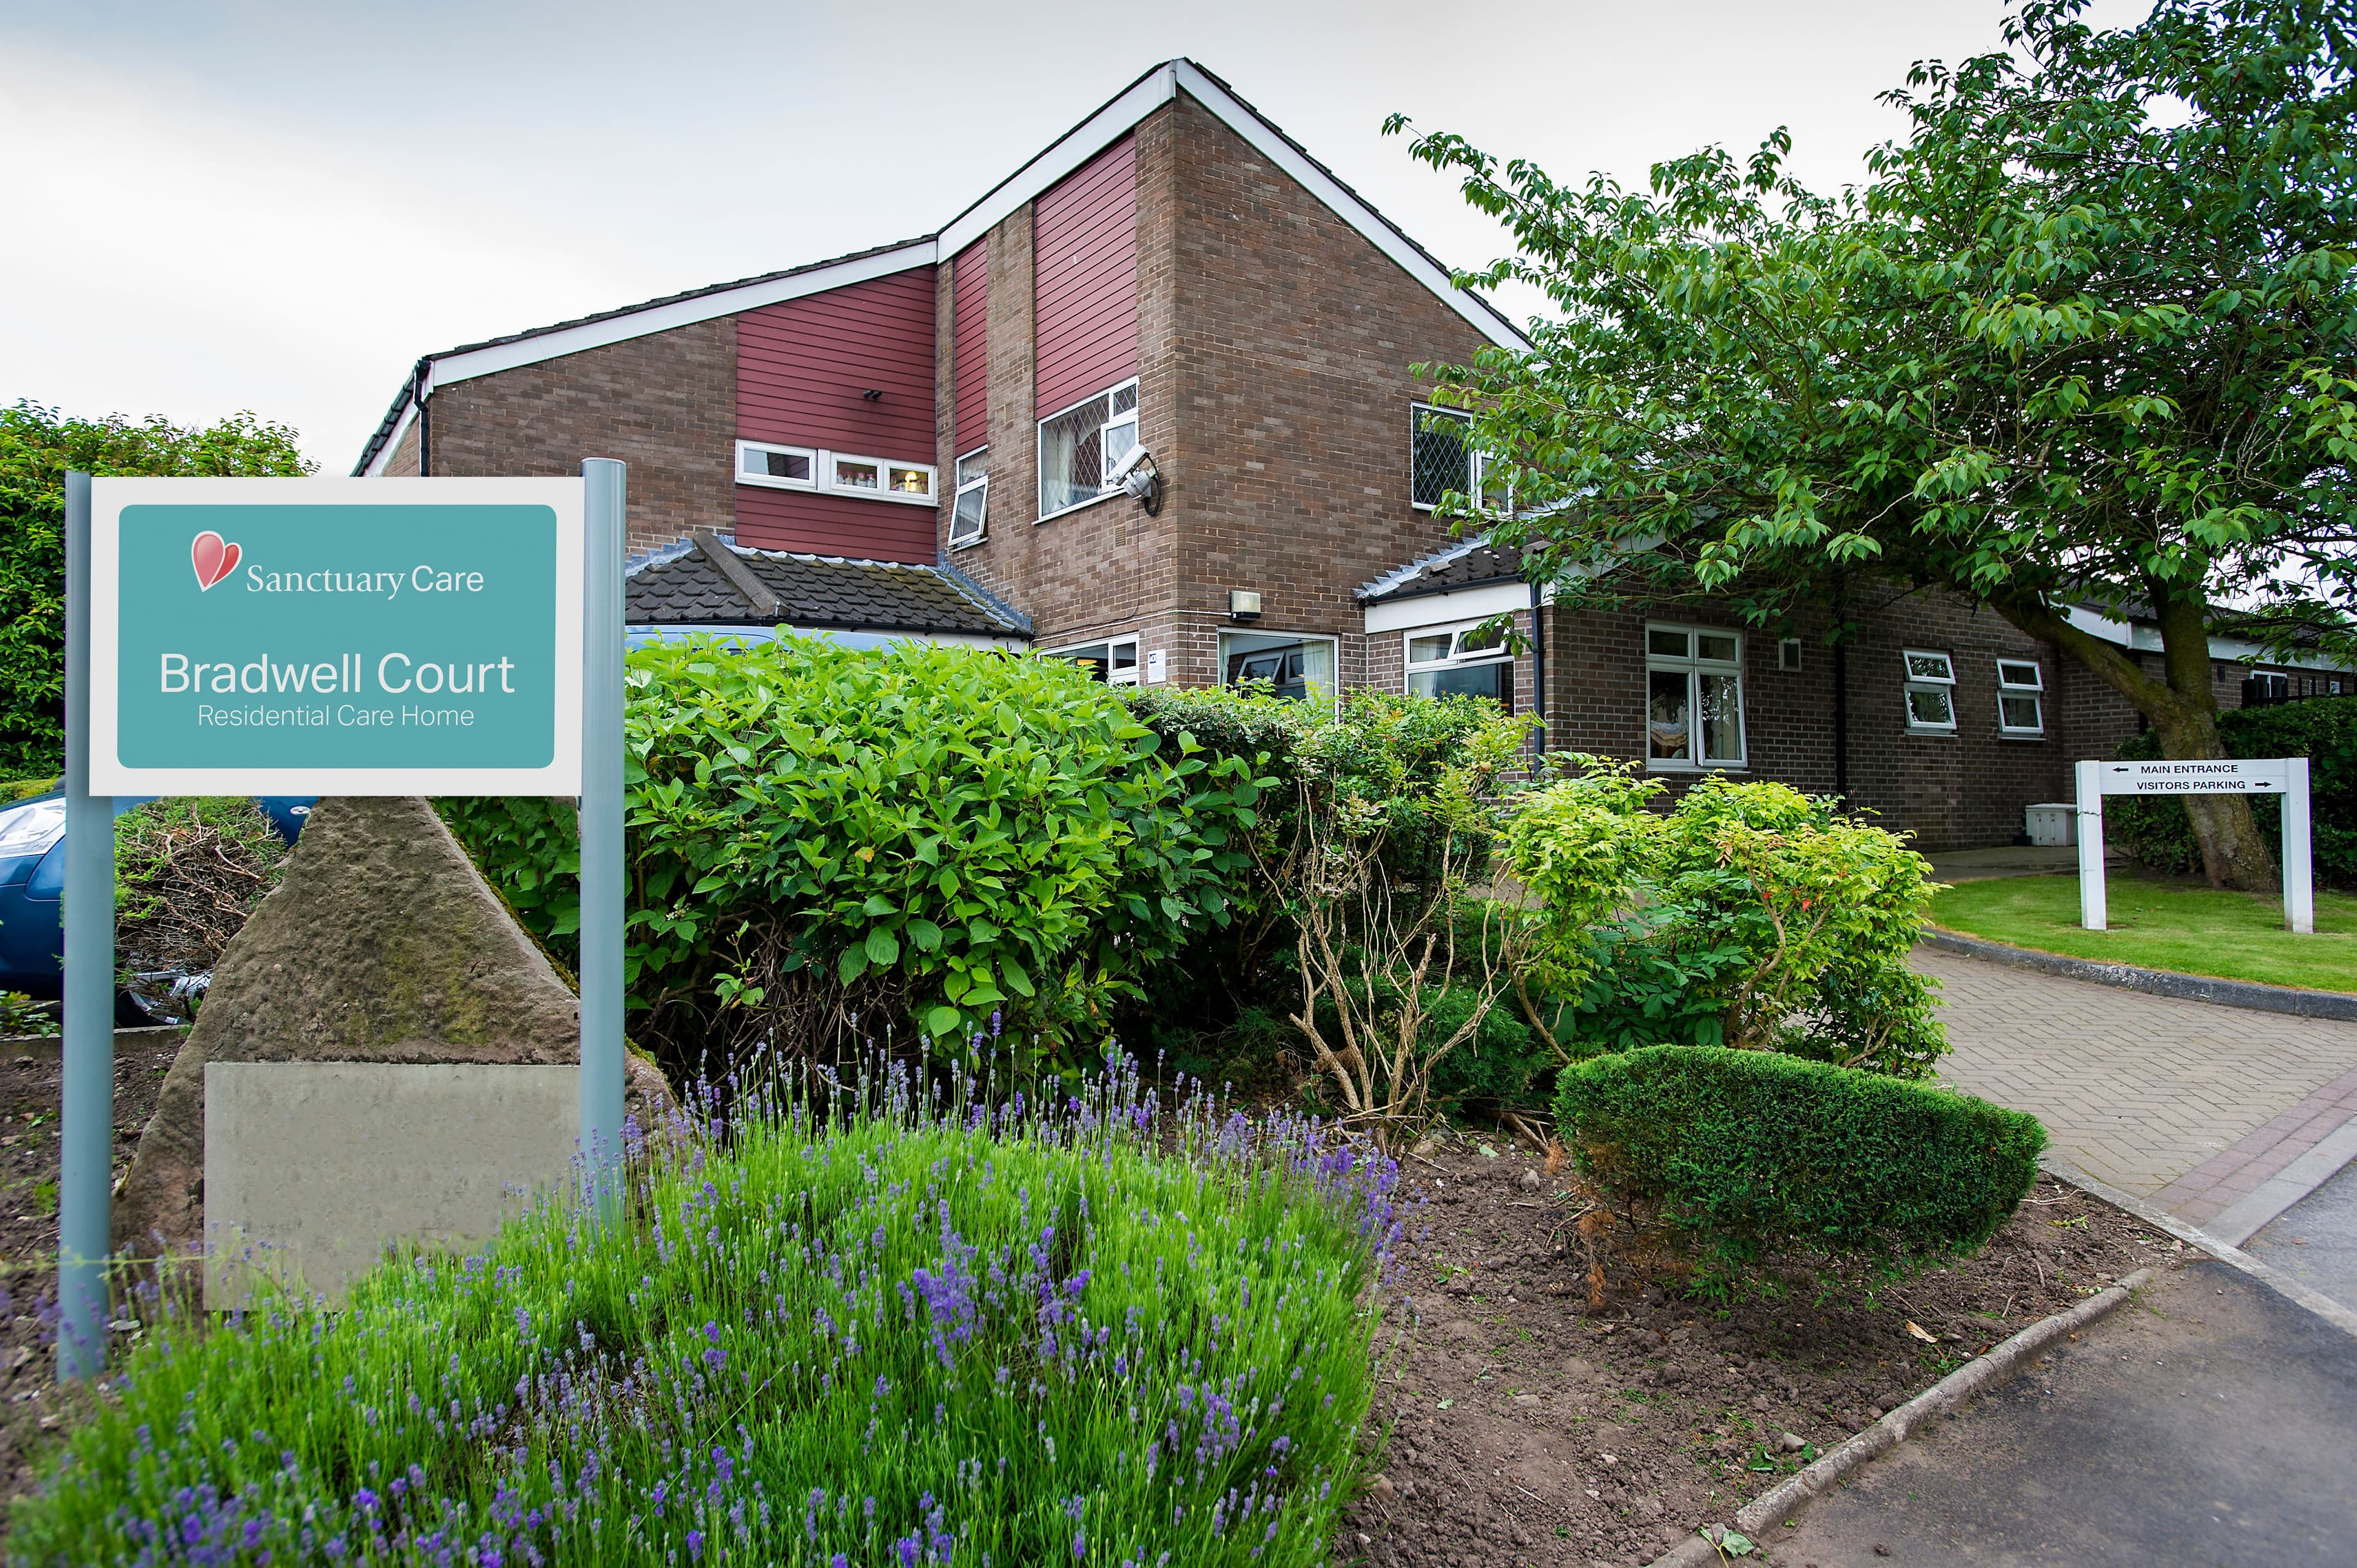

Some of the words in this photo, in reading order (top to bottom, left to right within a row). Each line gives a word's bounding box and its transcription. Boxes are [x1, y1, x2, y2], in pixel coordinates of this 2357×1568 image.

[247, 565, 406, 601] Sanctuary
[411, 565, 485, 593] Care
[161, 652, 361, 694] Bradwell
[377, 652, 515, 694] Court
[198, 704, 330, 727] Residential
[337, 703, 394, 727] Care
[401, 704, 474, 727] Home
[2140, 765, 2170, 774] MAIN
[2174, 765, 2239, 773] ENTRANCE
[2137, 781, 2190, 790] VISITORS
[2193, 781, 2245, 790] PARKING
